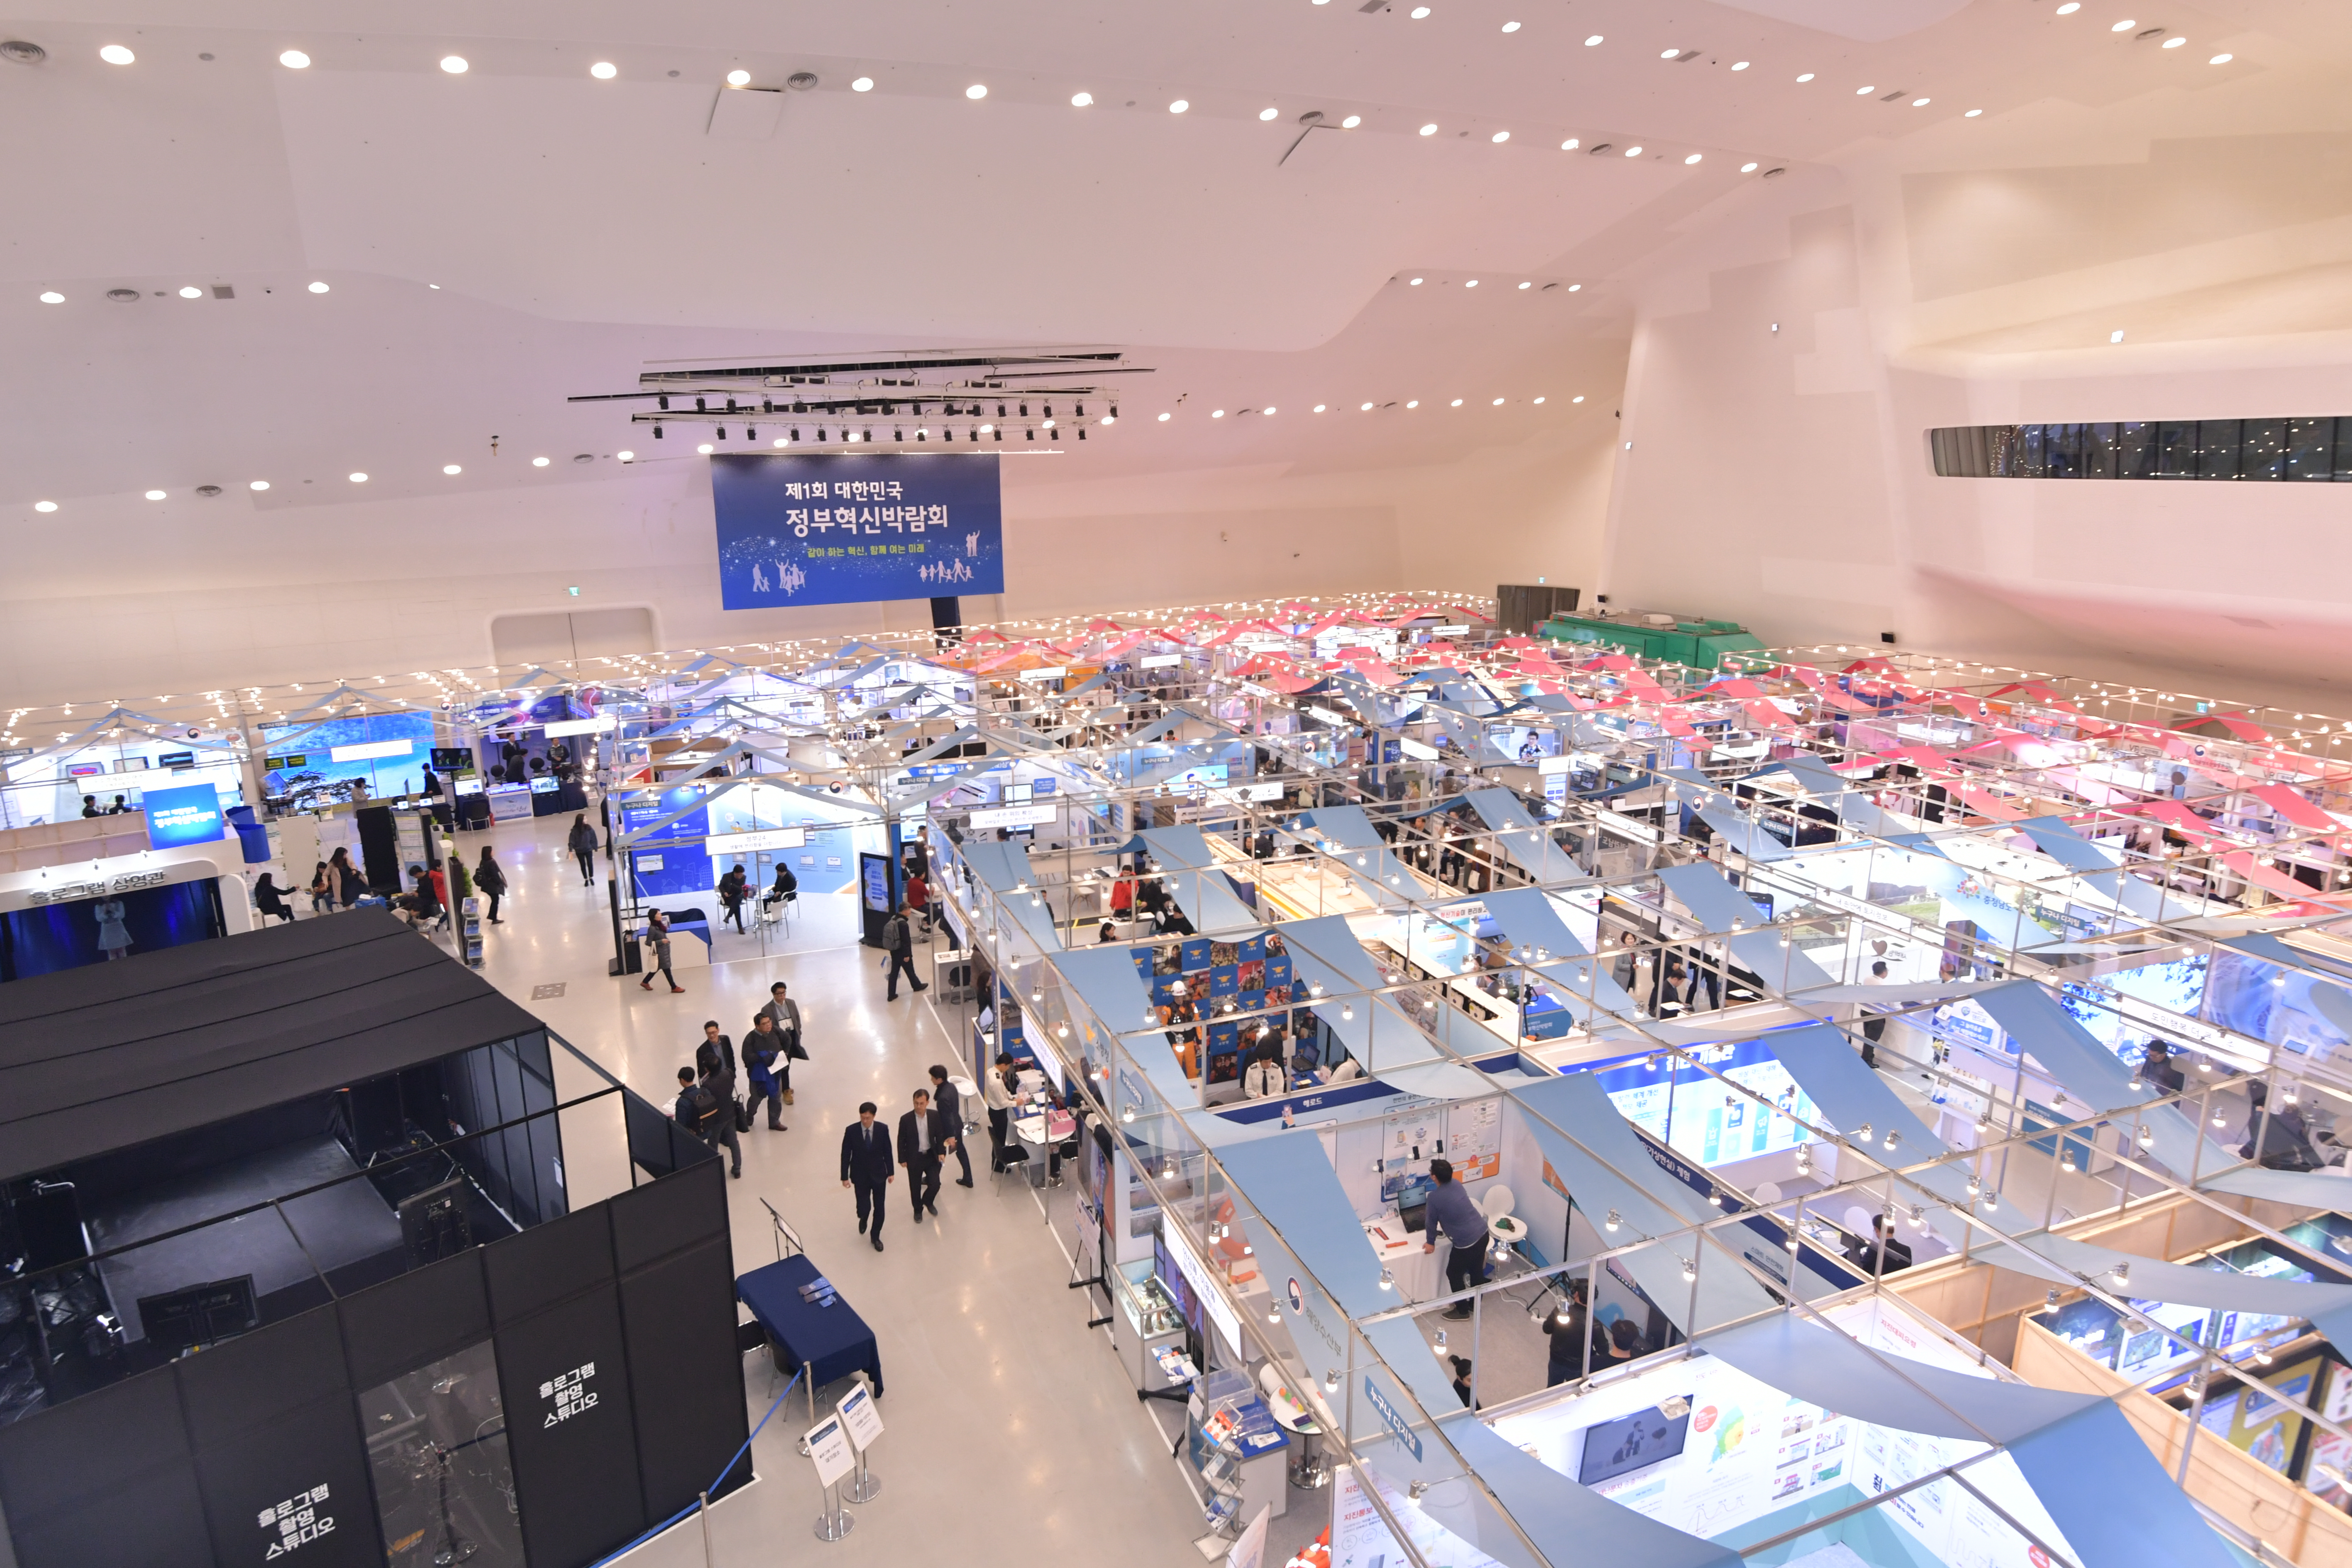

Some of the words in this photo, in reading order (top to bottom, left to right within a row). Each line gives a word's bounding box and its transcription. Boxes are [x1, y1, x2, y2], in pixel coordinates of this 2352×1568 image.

[786, 482, 828, 500] 제1회
[835, 481, 903, 501] 대한민국
[786, 505, 948, 537] 정부혁신박람회
[807, 548, 825, 558] 같이
[828, 547, 844, 557] 하는
[847, 546, 868, 556] 혁신,
[870, 545, 886, 555] 함께
[889, 544, 905, 554] 여는
[908, 543, 924, 553] 미래
[1764, 821, 1776, 829] 누구나
[1777, 825, 1790, 833] 디지털
[746, 835, 766, 843] 정부24
[30, 881, 104, 904] 홀로그램
[112, 870, 165, 893] 상영관
[1441, 910, 1465, 918] 혁신기술이
[1844, 900, 1861, 912] 손안에
[1864, 906, 1888, 921] 토지정보
[1984, 895, 2012, 912] 충청남도
[2040, 908, 2060, 921] 누구나
[2061, 915, 2080, 927] 디지털
[2151, 1013, 2187, 1032] 도민행복
[2191, 1026, 2198, 1035] 더
[1303, 1097, 1323, 1107] 해로드
[1677, 1166, 1690, 1181] 체험
[1306, 1307, 1342, 1358] 해양수산부
[1881, 1318, 1916, 1348] 지진대피요령
[539, 1361, 595, 1399] 홀로그램
[555, 1383, 583, 1407] 촬영
[544, 1392, 599, 1428] 스튜디오
[1369, 1386, 1392, 1422] 누구나
[1392, 1416, 1416, 1452] 디지털
[825, 1451, 841, 1462] 대기장소
[258, 1483, 329, 1527] 홀로그램
[1344, 1506, 1374, 1521] 지진통보
[278, 1508, 315, 1536] 촬영
[265, 1517, 335, 1560] 스튜디오
